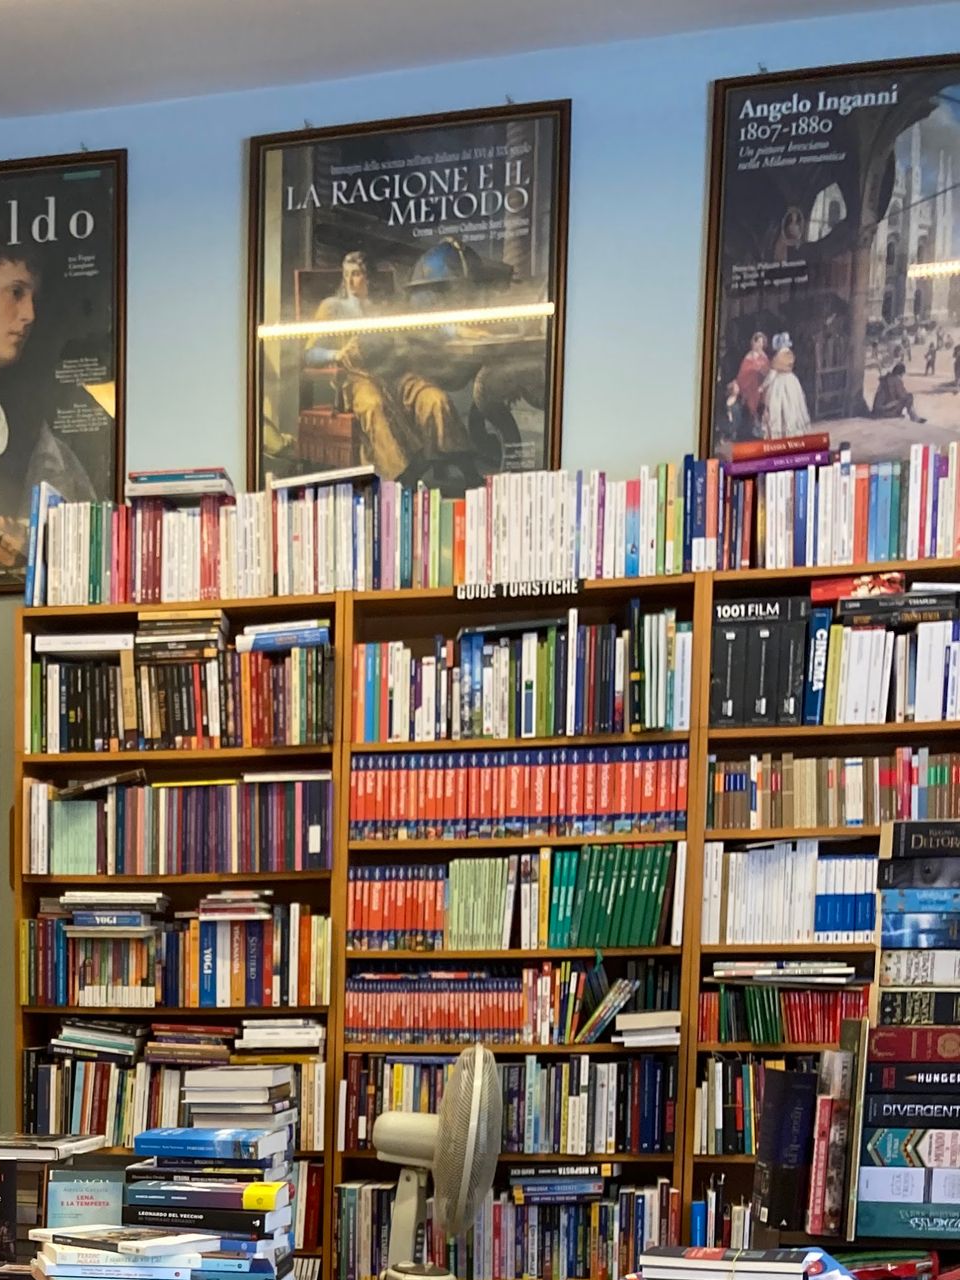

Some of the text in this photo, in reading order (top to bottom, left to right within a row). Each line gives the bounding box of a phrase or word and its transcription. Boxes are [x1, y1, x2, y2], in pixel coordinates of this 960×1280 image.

[739, 83, 898, 123] Angelo Inganni
[739, 115, 833, 142] 1807-1880
[286, 160, 530, 211] LA RAGIONE E IL
[388, 187, 528, 226] METODO
[456, 579, 579, 600] GUIDE TURISTICHE
[716, 602, 780, 619] 1001 FILM
[95, 915, 117, 925] YOGI
[203, 948, 213, 975] YOGI
